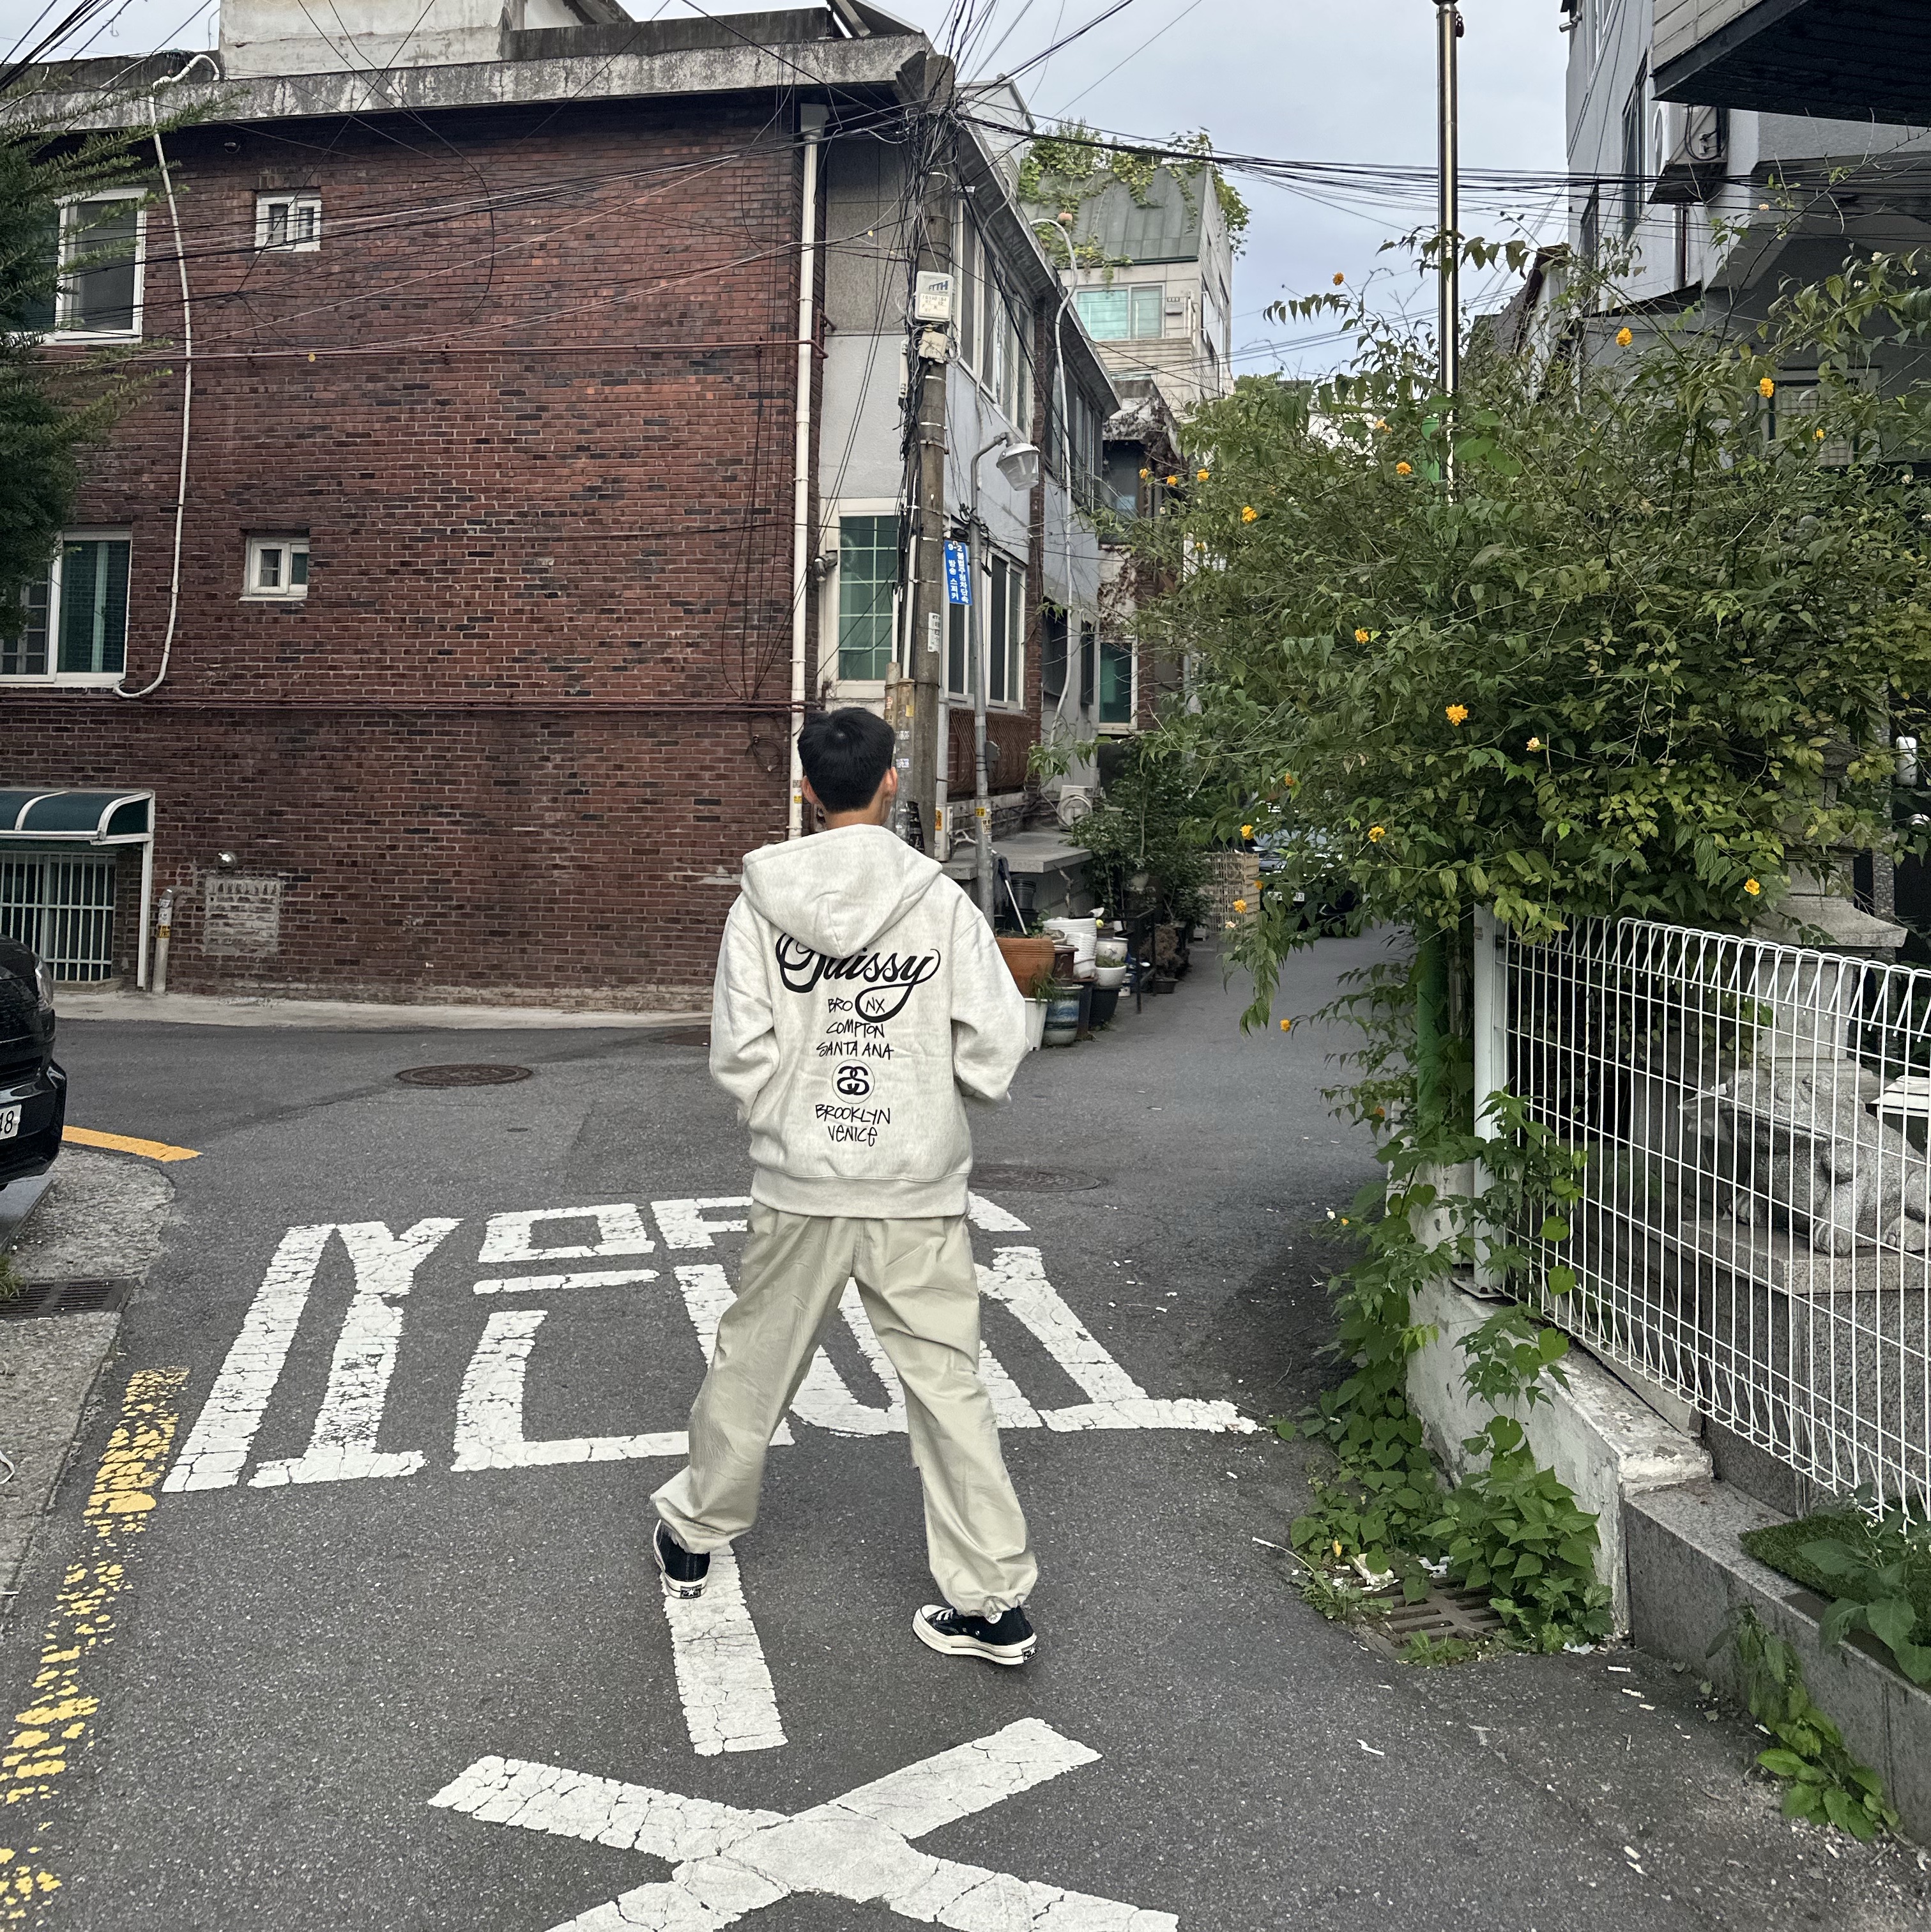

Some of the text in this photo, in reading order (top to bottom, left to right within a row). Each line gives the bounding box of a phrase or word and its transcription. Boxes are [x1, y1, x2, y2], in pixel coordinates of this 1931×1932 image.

[928, 280, 949, 291] FTTH
[948, 543, 963, 552] 9-2
[948, 559, 959, 601] 방송 스피커
[826, 1018, 885, 1038] COMPTON
[816, 1041, 894, 1060] SANTA ANA
[815, 1104, 890, 1125] BROOKLYN
